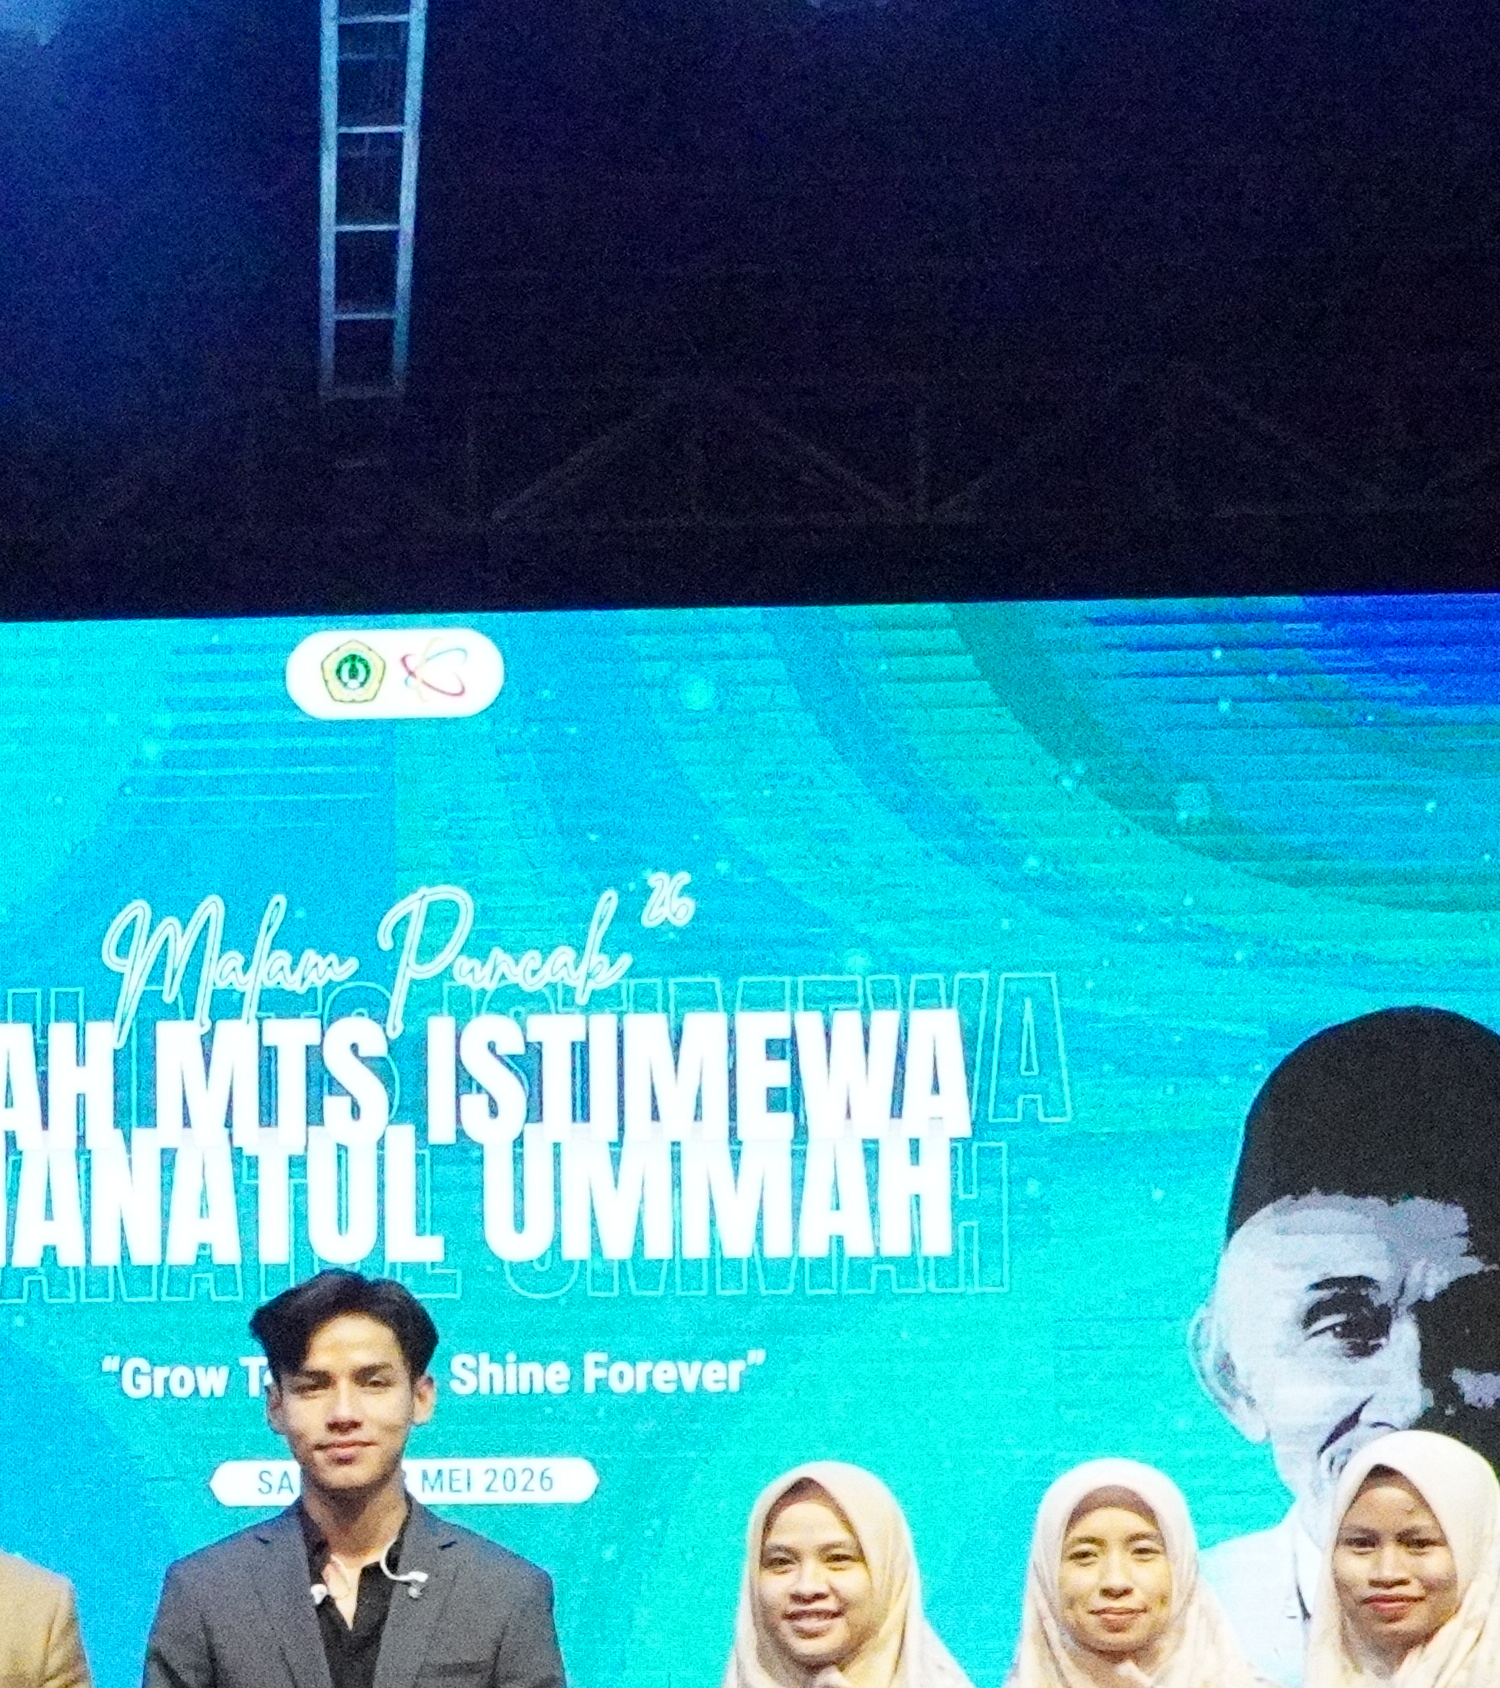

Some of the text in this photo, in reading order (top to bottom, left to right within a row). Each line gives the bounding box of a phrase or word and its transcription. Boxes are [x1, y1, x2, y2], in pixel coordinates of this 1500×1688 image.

[639, 870, 696, 928] 26
[155, 1015, 390, 1149] MTS
[427, 1008, 973, 1146] ISTIMEWA
[482, 1117, 953, 1263] UMMAH
[449, 1352, 571, 1396] Shine
[421, 1467, 472, 1494] MEI
[483, 1466, 554, 1494] 2026
